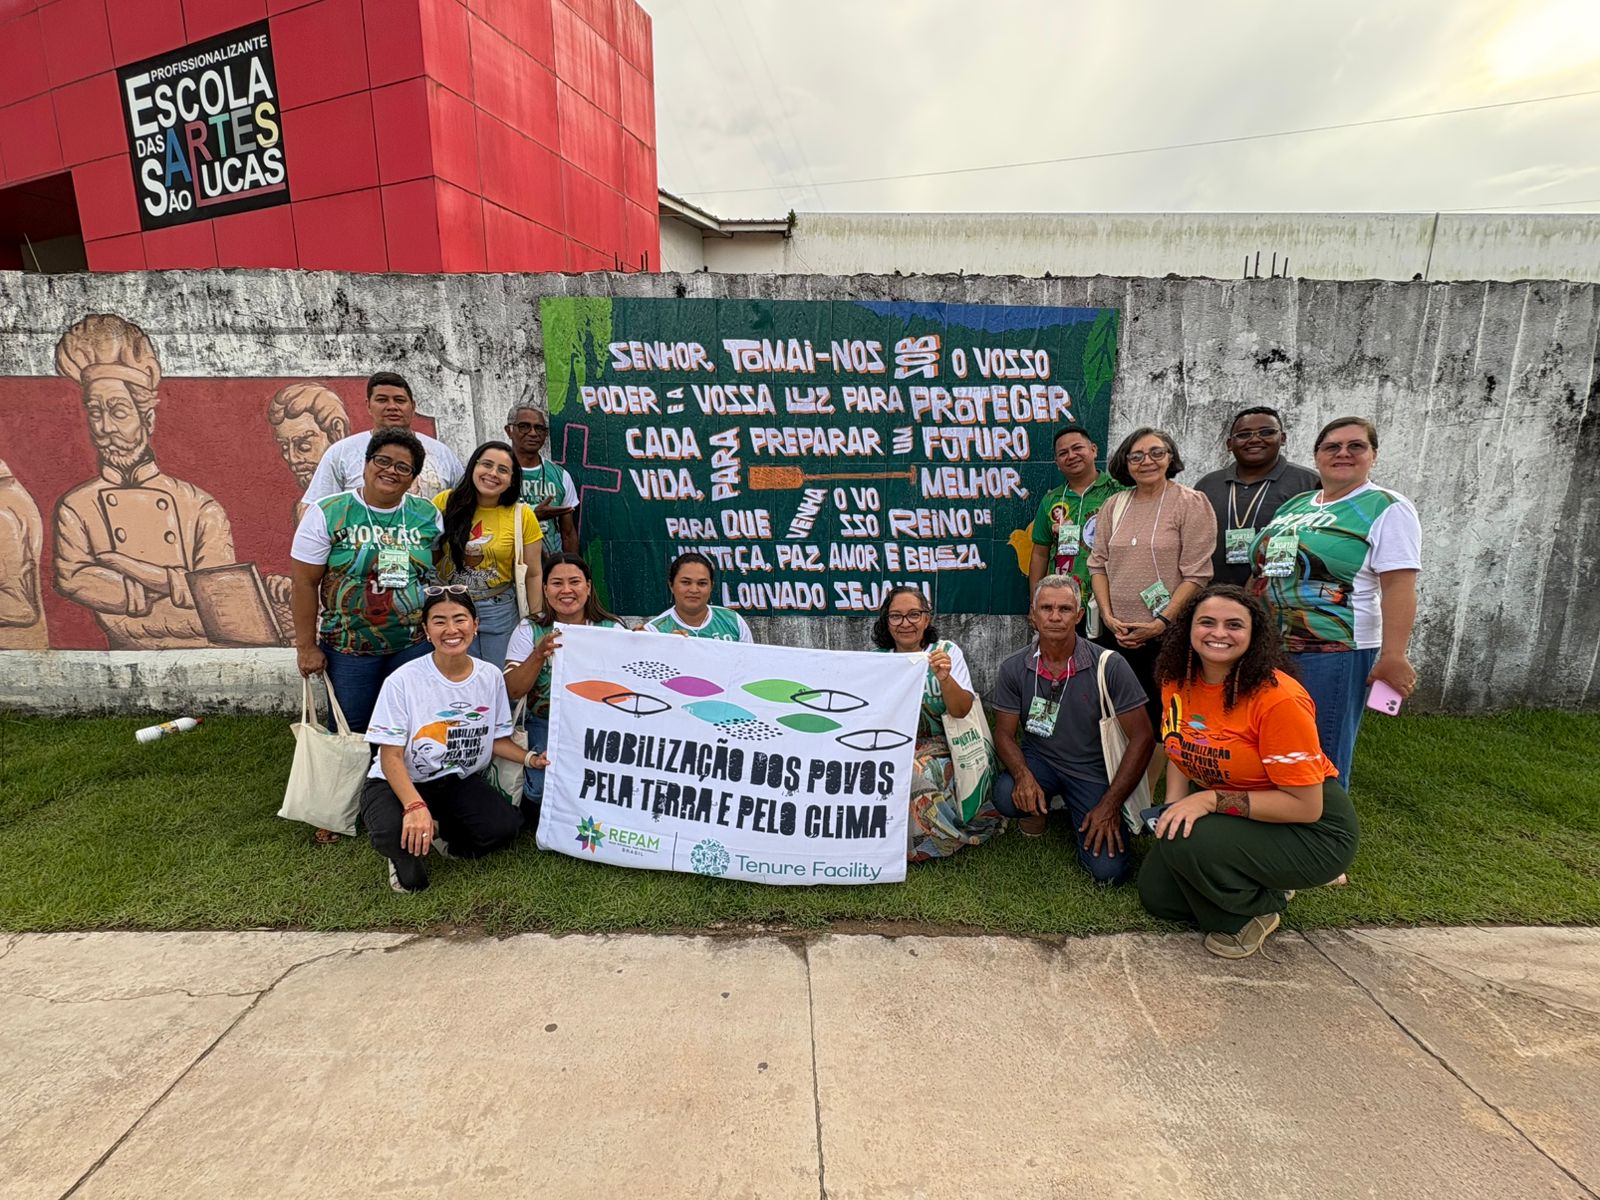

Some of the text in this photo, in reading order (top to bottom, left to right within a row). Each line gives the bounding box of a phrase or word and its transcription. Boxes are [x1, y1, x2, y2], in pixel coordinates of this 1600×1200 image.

[150, 34, 268, 82] PROFISSIONALIZANTE
[125, 56, 273, 138] ESCOLA
[136, 101, 279, 188] DAS ARTES
[141, 158, 192, 217] SÃO
[894, 334, 941, 379] SOB
[951, 348, 968, 379] O
[972, 347, 1050, 379] VOSSO
[580, 385, 662, 415] PODER
[691, 383, 777, 416] VOSSA
[841, 385, 906, 414] PARA
[908, 384, 1076, 425] PROTEGER
[625, 426, 702, 460] CADA
[749, 425, 1030, 461] PREPARAR UM FUTURO
[709, 426, 742, 501] PARA
[629, 467, 705, 501] VIDA,
[833, 487, 881, 511] O VO
[665, 487, 828, 540] PARA QUE VENHA
[888, 508, 973, 539] REINO
[974, 509, 992, 525] DE
[829, 542, 881, 572] AMOR
[884, 542, 901, 572] E
[904, 543, 987, 572] BELEZA.
[722, 581, 826, 611] LOUVADO
[584, 727, 895, 799] MOBILIZAÇÃO DOS POVOS
[579, 768, 887, 839] PELA TERRA E PELO CLIMA
[609, 828, 660, 850] REPAM
[621, 847, 644, 857] BRASIL
[735, 854, 882, 881] Tenure Facility
